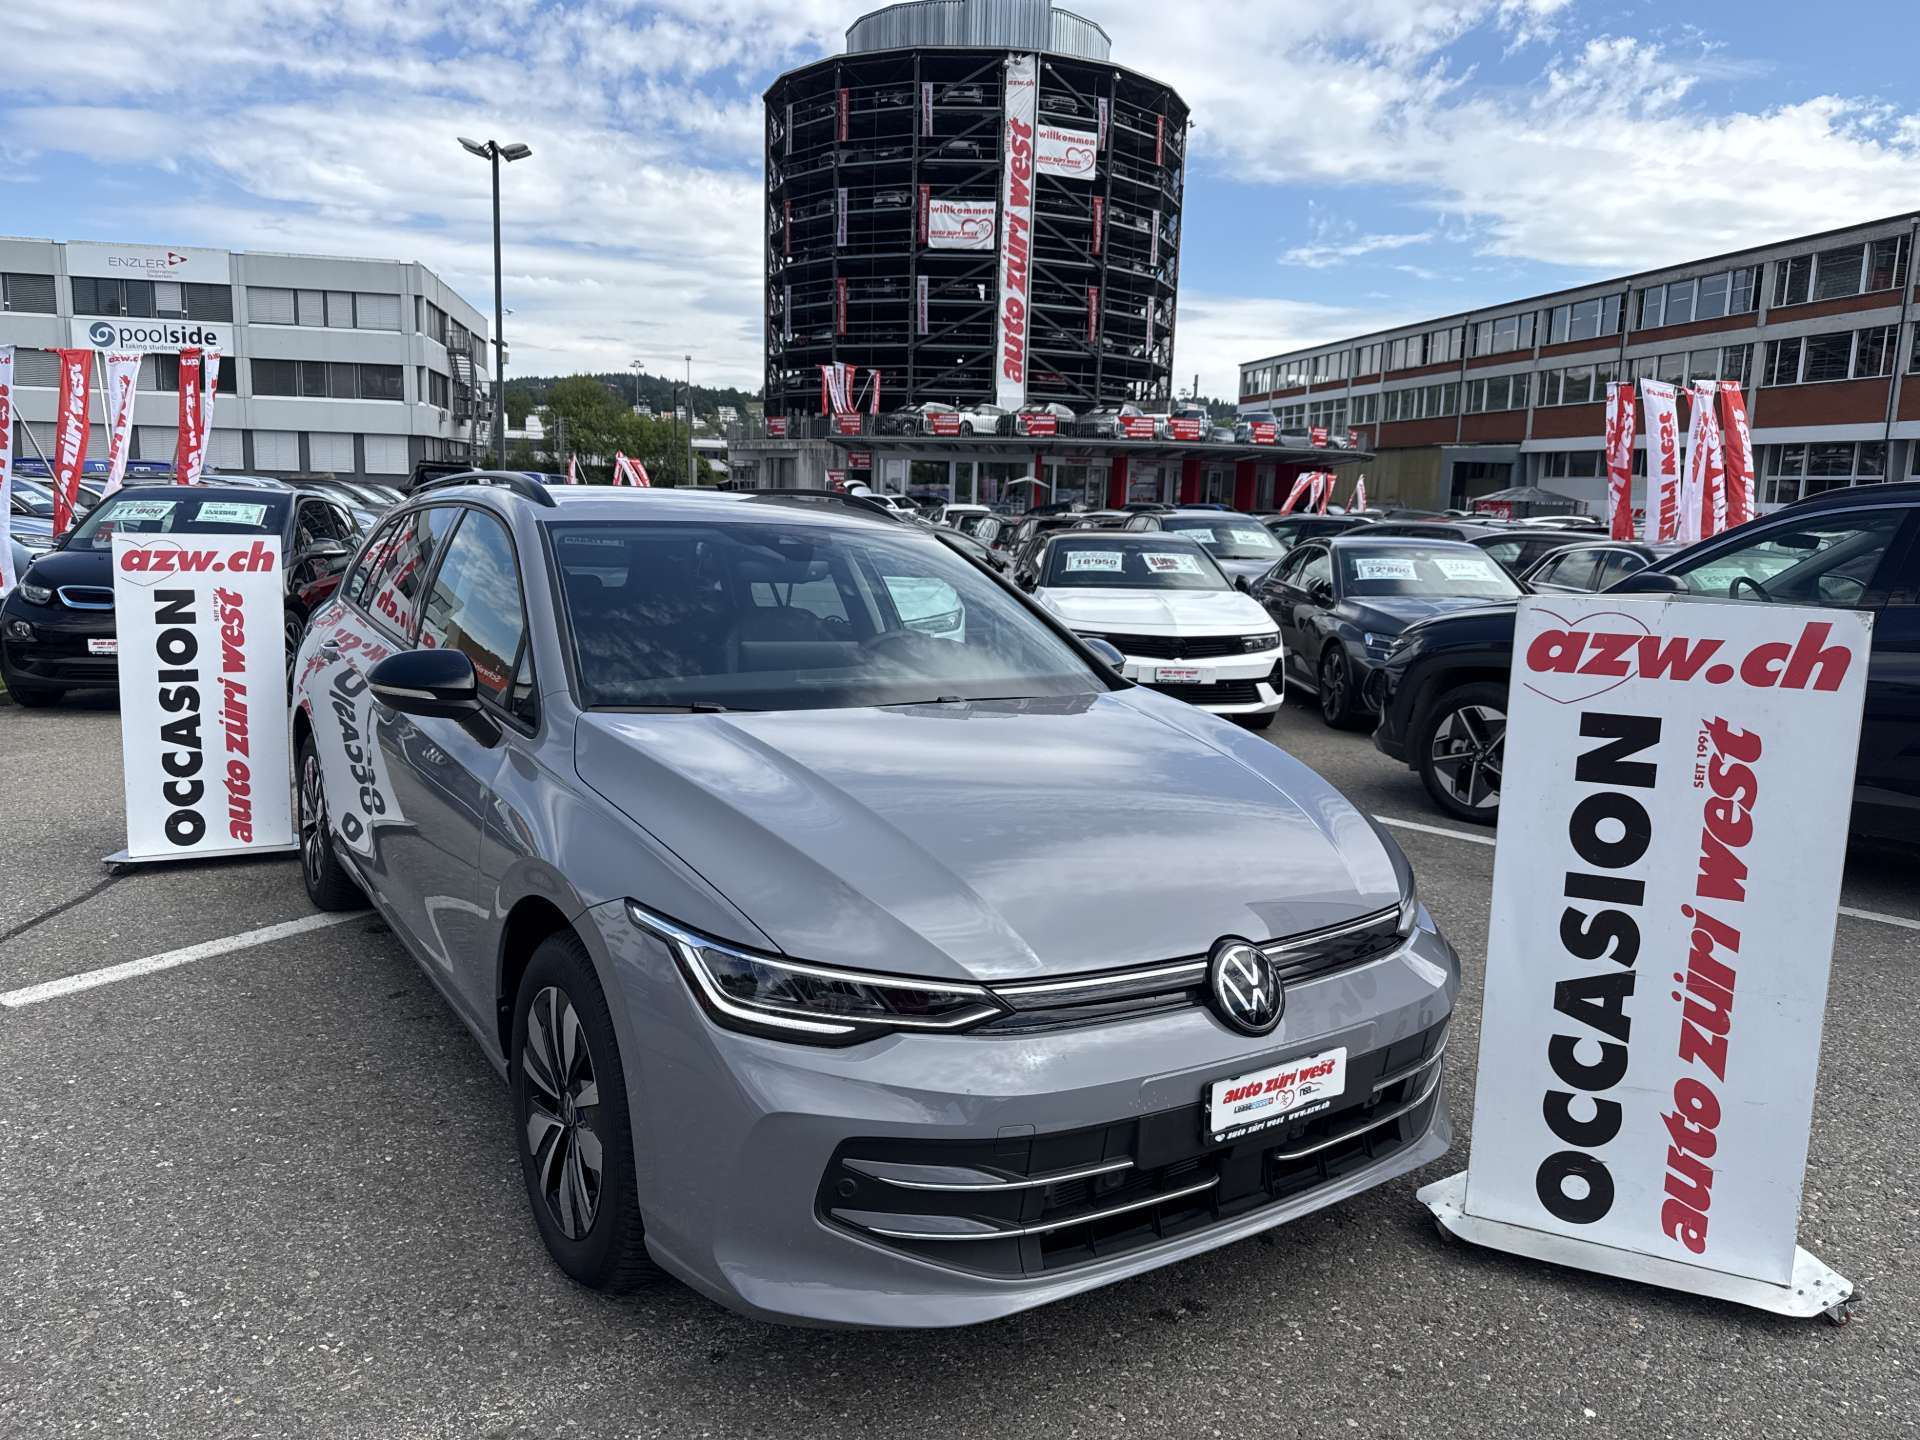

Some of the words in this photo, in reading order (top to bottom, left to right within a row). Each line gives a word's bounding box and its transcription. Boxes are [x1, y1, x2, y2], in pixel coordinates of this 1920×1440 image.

[1009, 117, 1032, 207] west
[1039, 129, 1095, 146] willkommen
[930, 204, 994, 215] willkommen
[108, 256, 166, 268] ENZLER
[1003, 209, 1030, 297] züri
[120, 325, 216, 348] poolside
[126, 344, 148, 352] taking
[1003, 297, 1025, 383] auto
[121, 541, 275, 572] azw.ch
[213, 587, 246, 673] west
[1526, 622, 1852, 692] azw.ch
[154, 589, 206, 847] OCCASION
[217, 677, 249, 758] züri
[1696, 730, 1710, 758] 1991
[222, 759, 254, 843] auto
[1694, 762, 1705, 788] SEIT
[1695, 715, 1762, 903] west
[1535, 711, 1663, 1225] OCCASION
[1671, 903, 1741, 1084] züri
[1222, 1081, 1262, 1104] auto
[1263, 1068, 1298, 1094] züri
[1299, 1060, 1336, 1082] west
[1226, 1128, 1246, 1140] auto
[1248, 1121, 1266, 1134] züri
[1266, 1116, 1285, 1127] west
[1288, 1100, 1331, 1120] www.azw.ch
[1660, 1077, 1721, 1256] auto
